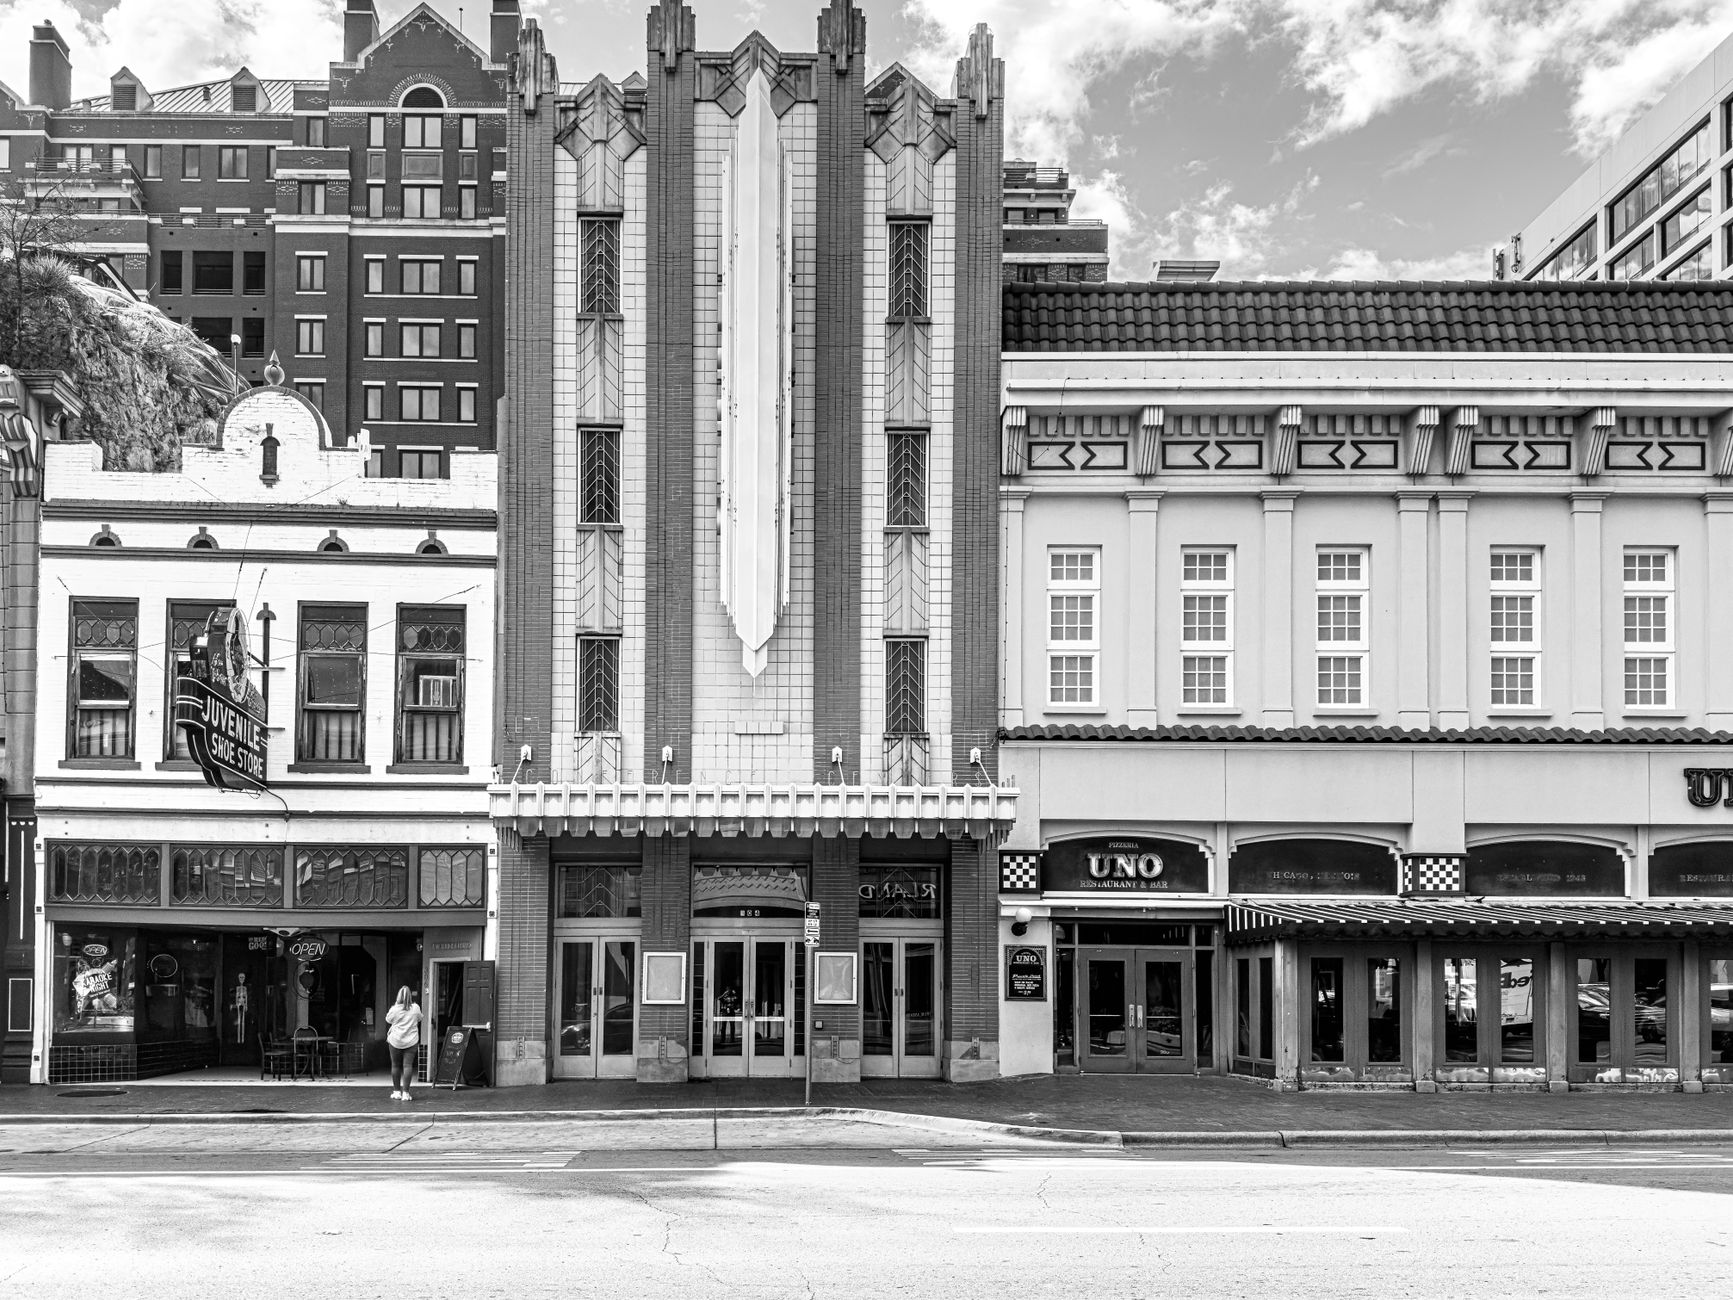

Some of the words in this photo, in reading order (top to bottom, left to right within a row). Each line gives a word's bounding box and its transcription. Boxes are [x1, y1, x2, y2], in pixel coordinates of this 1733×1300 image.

[202, 695, 260, 751] JUVENILE
[212, 732, 235, 764] SHOE
[238, 747, 263, 779] STORE
[1684, 768, 1733, 808] U
[1087, 852, 1164, 879] UNO
[1080, 880, 1138, 889] RESTAURANT
[1140, 881, 1147, 889] &
[1150, 881, 1168, 889] BAR
[85, 946, 107, 954] OPEN
[292, 943, 325, 955] OPEN
